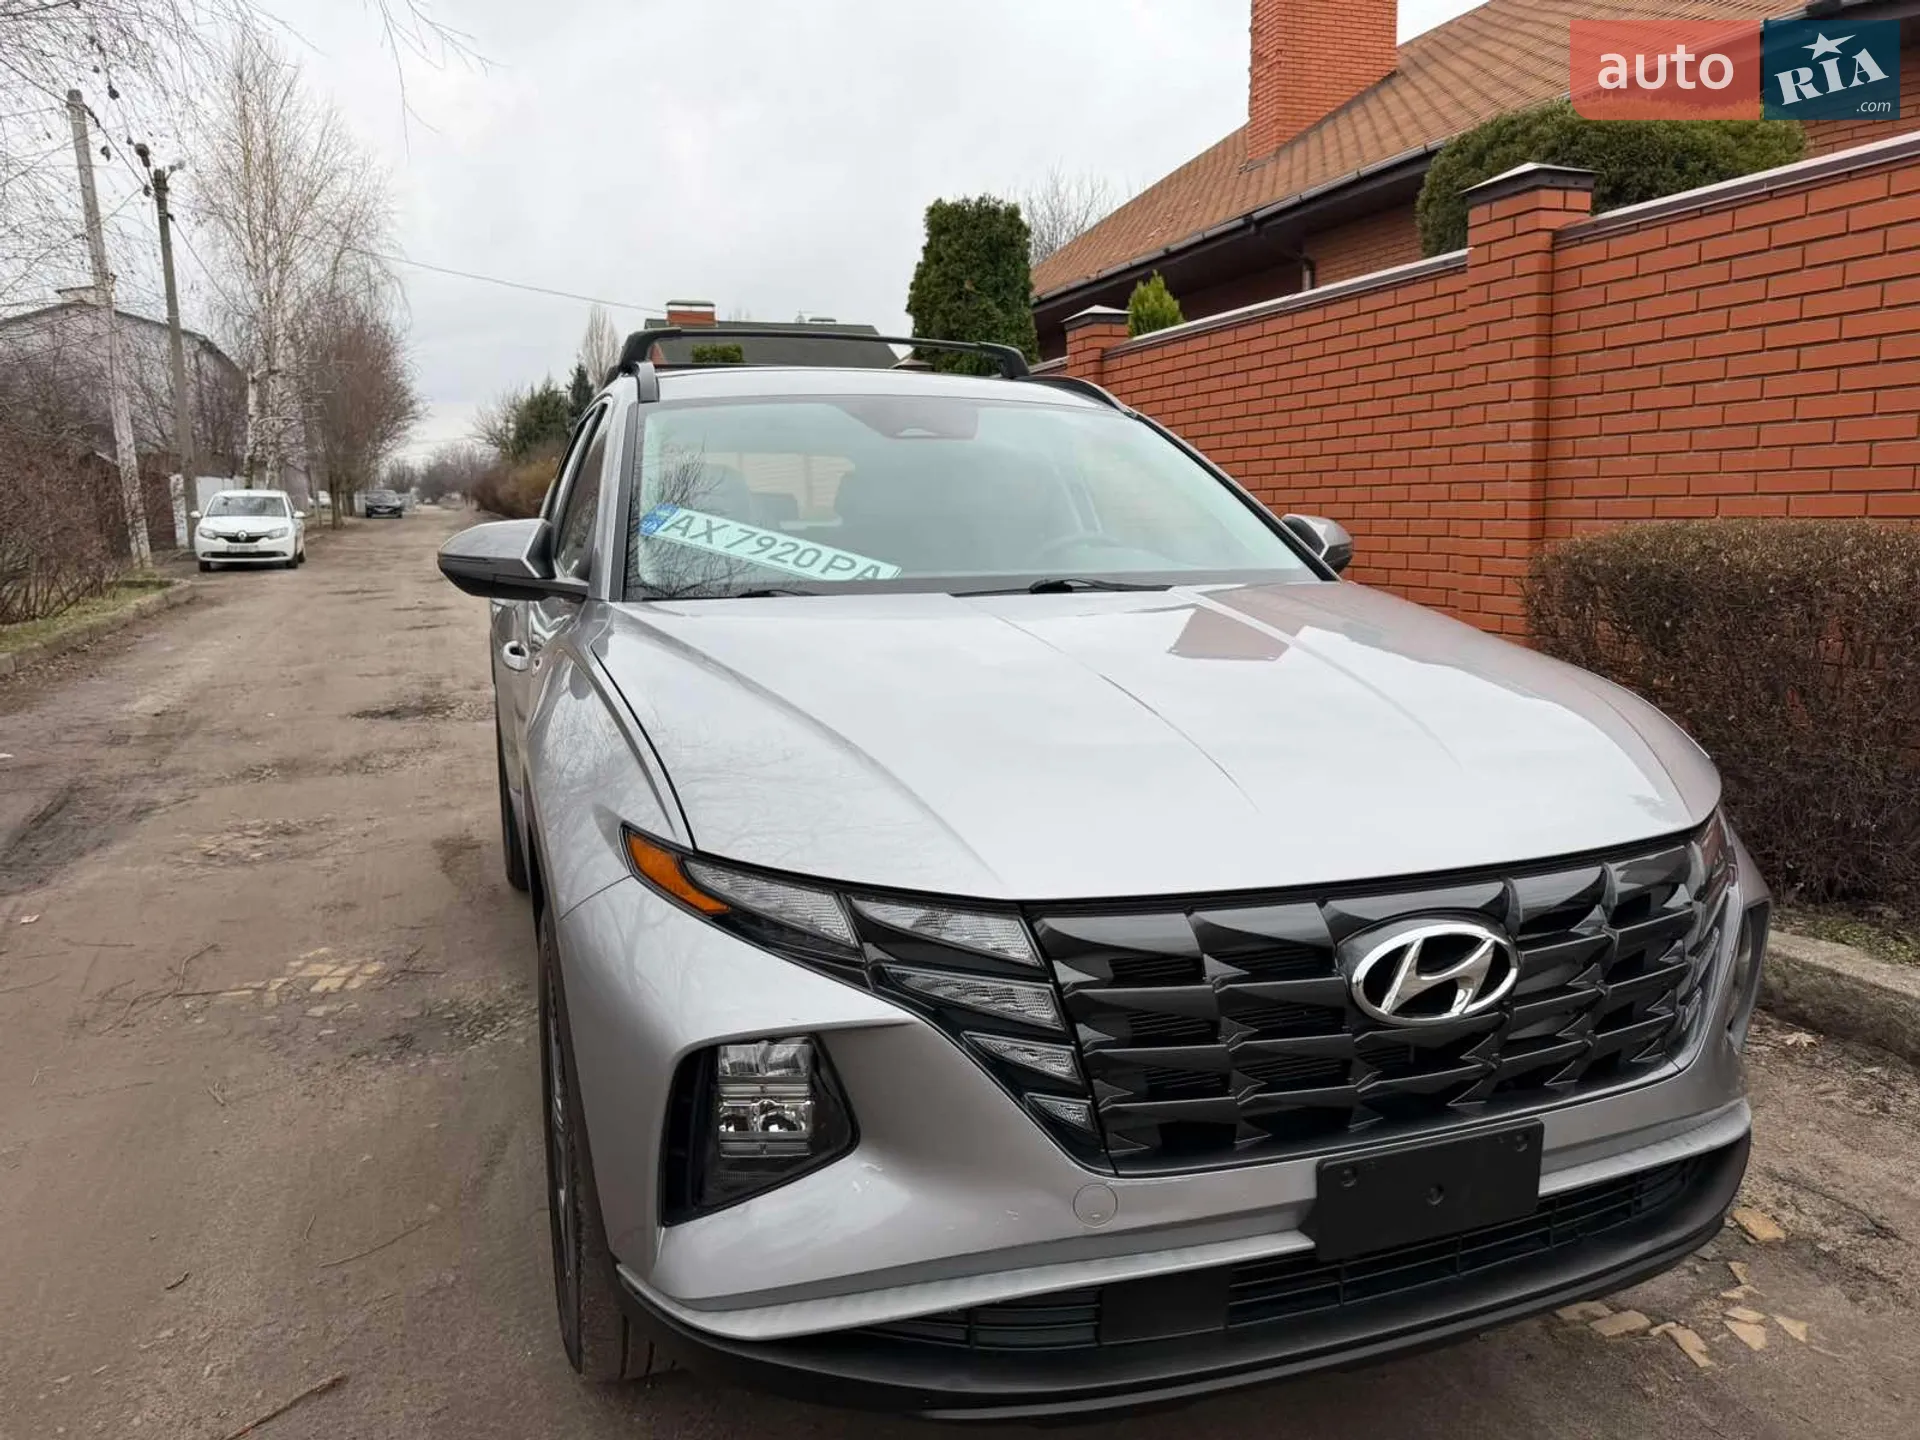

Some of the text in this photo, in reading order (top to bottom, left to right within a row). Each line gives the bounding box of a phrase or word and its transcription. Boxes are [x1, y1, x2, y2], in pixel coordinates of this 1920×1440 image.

[663, 514, 730, 545] AX
[724, 528, 823, 569] 7920
[820, 554, 882, 581] PA
